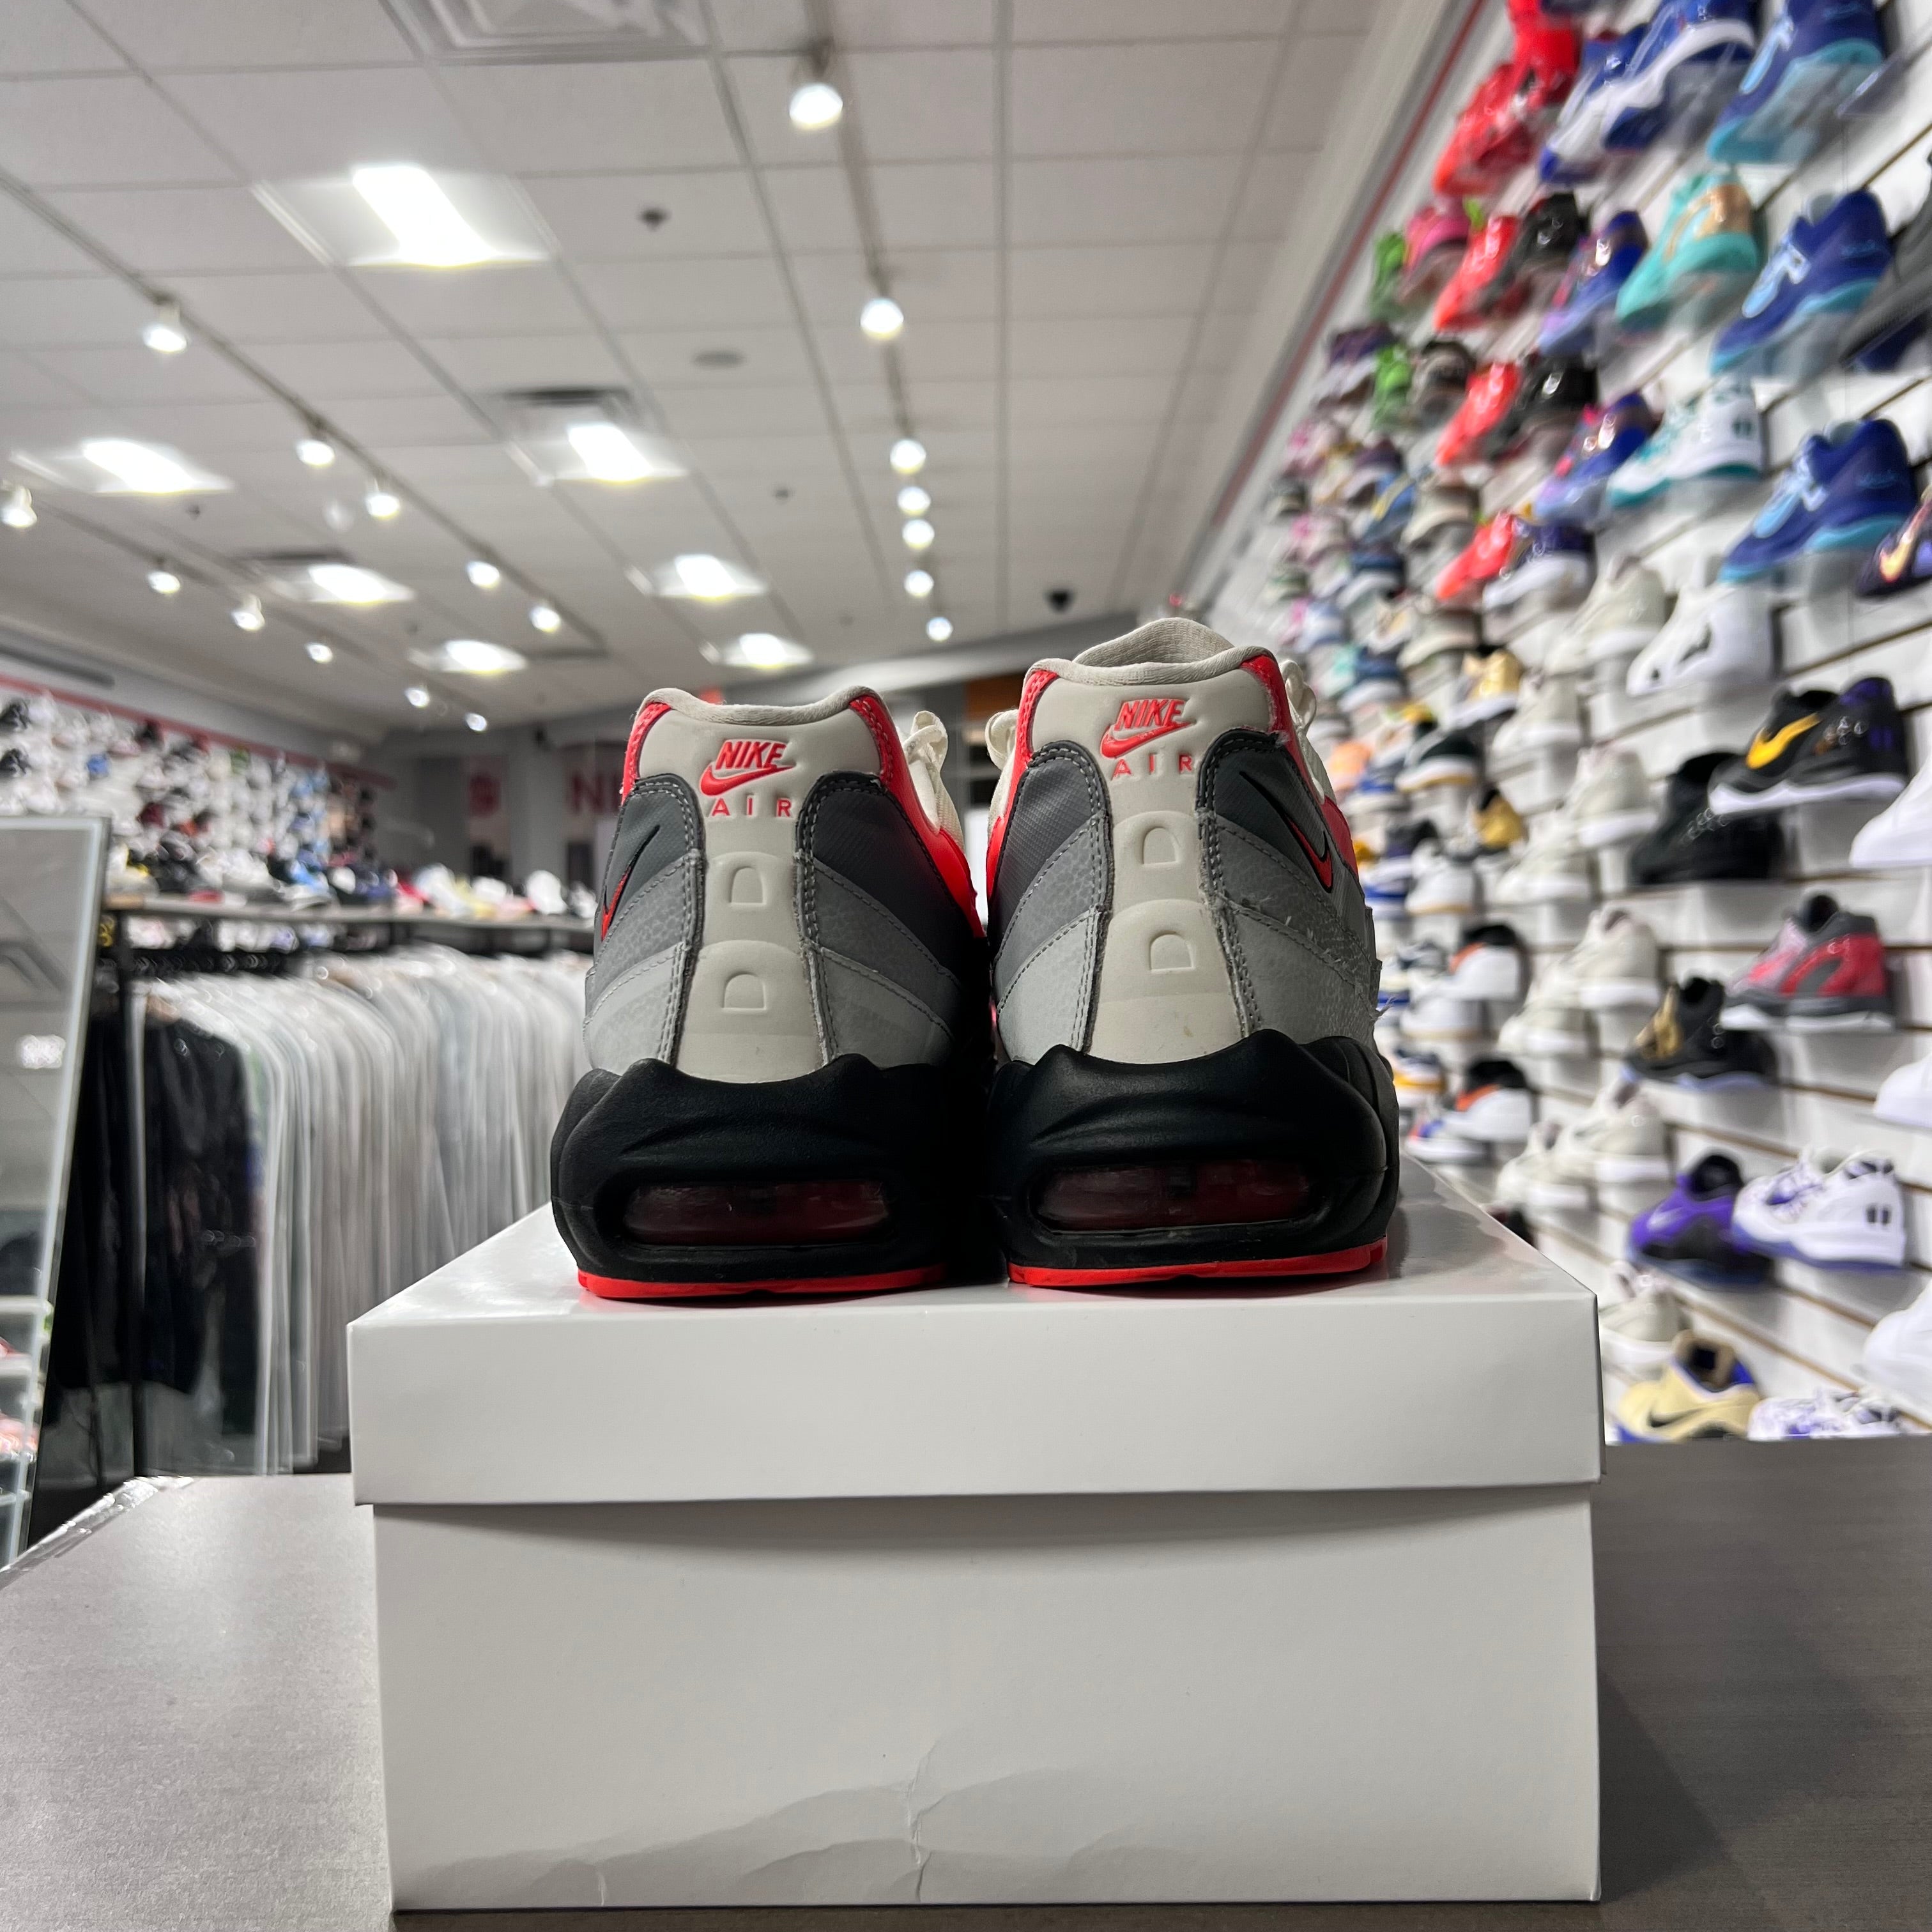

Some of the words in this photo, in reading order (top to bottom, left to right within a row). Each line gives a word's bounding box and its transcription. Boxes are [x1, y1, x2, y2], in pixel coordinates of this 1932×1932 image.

[1114, 699, 1185, 731] NIKE
[716, 741, 786, 769] NIKE
[1111, 753, 1193, 781] AIR
[711, 797, 792, 817] AIR
